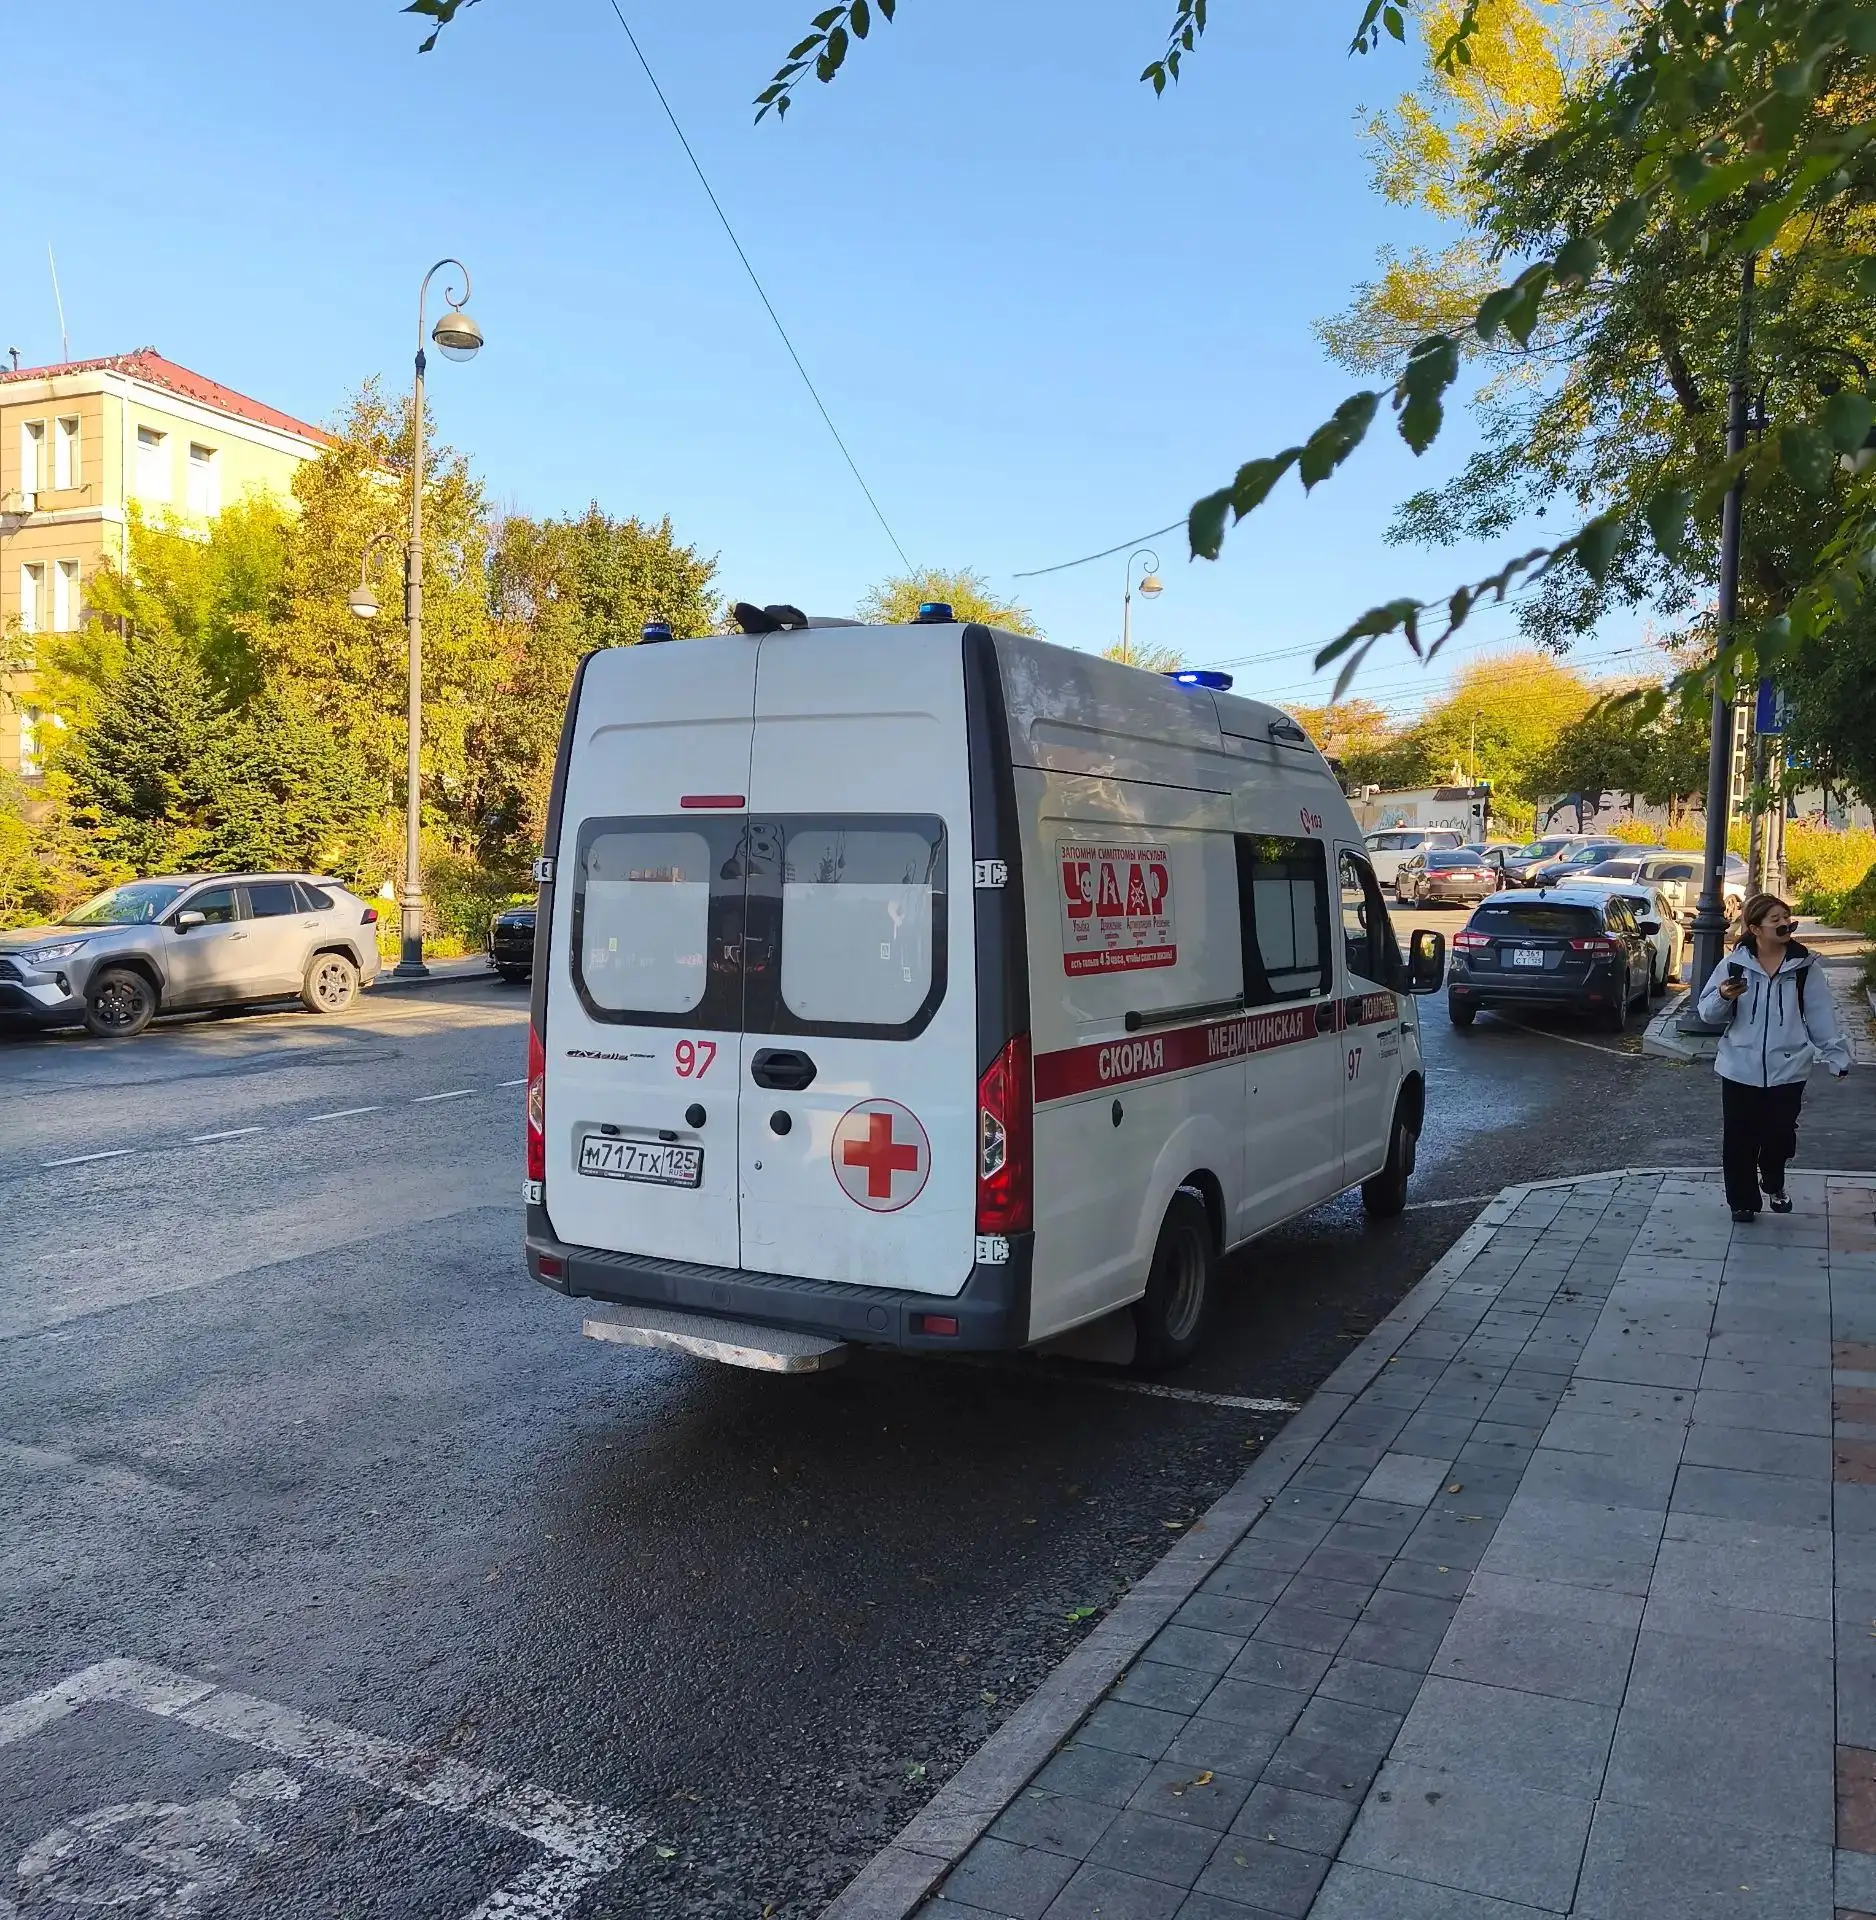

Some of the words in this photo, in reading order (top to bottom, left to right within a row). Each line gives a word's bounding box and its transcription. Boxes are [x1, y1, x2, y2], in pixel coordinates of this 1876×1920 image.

[1310, 814, 1322, 829] 103
[1061, 846, 1096, 859] ЗАПОМНИ
[1098, 848, 1135, 860] СИМПТОМЫ
[1137, 849, 1167, 861] ИНСУЛЬТА
[1099, 1038, 1163, 1080] СКОРАЯ
[1208, 1011, 1304, 1056] МЕДИЦИНСКАЯ
[675, 1039, 717, 1079] 97
[1348, 1047, 1362, 1081] 97
[665, 1149, 697, 1170] 125
[668, 1168, 684, 1177] RUS
